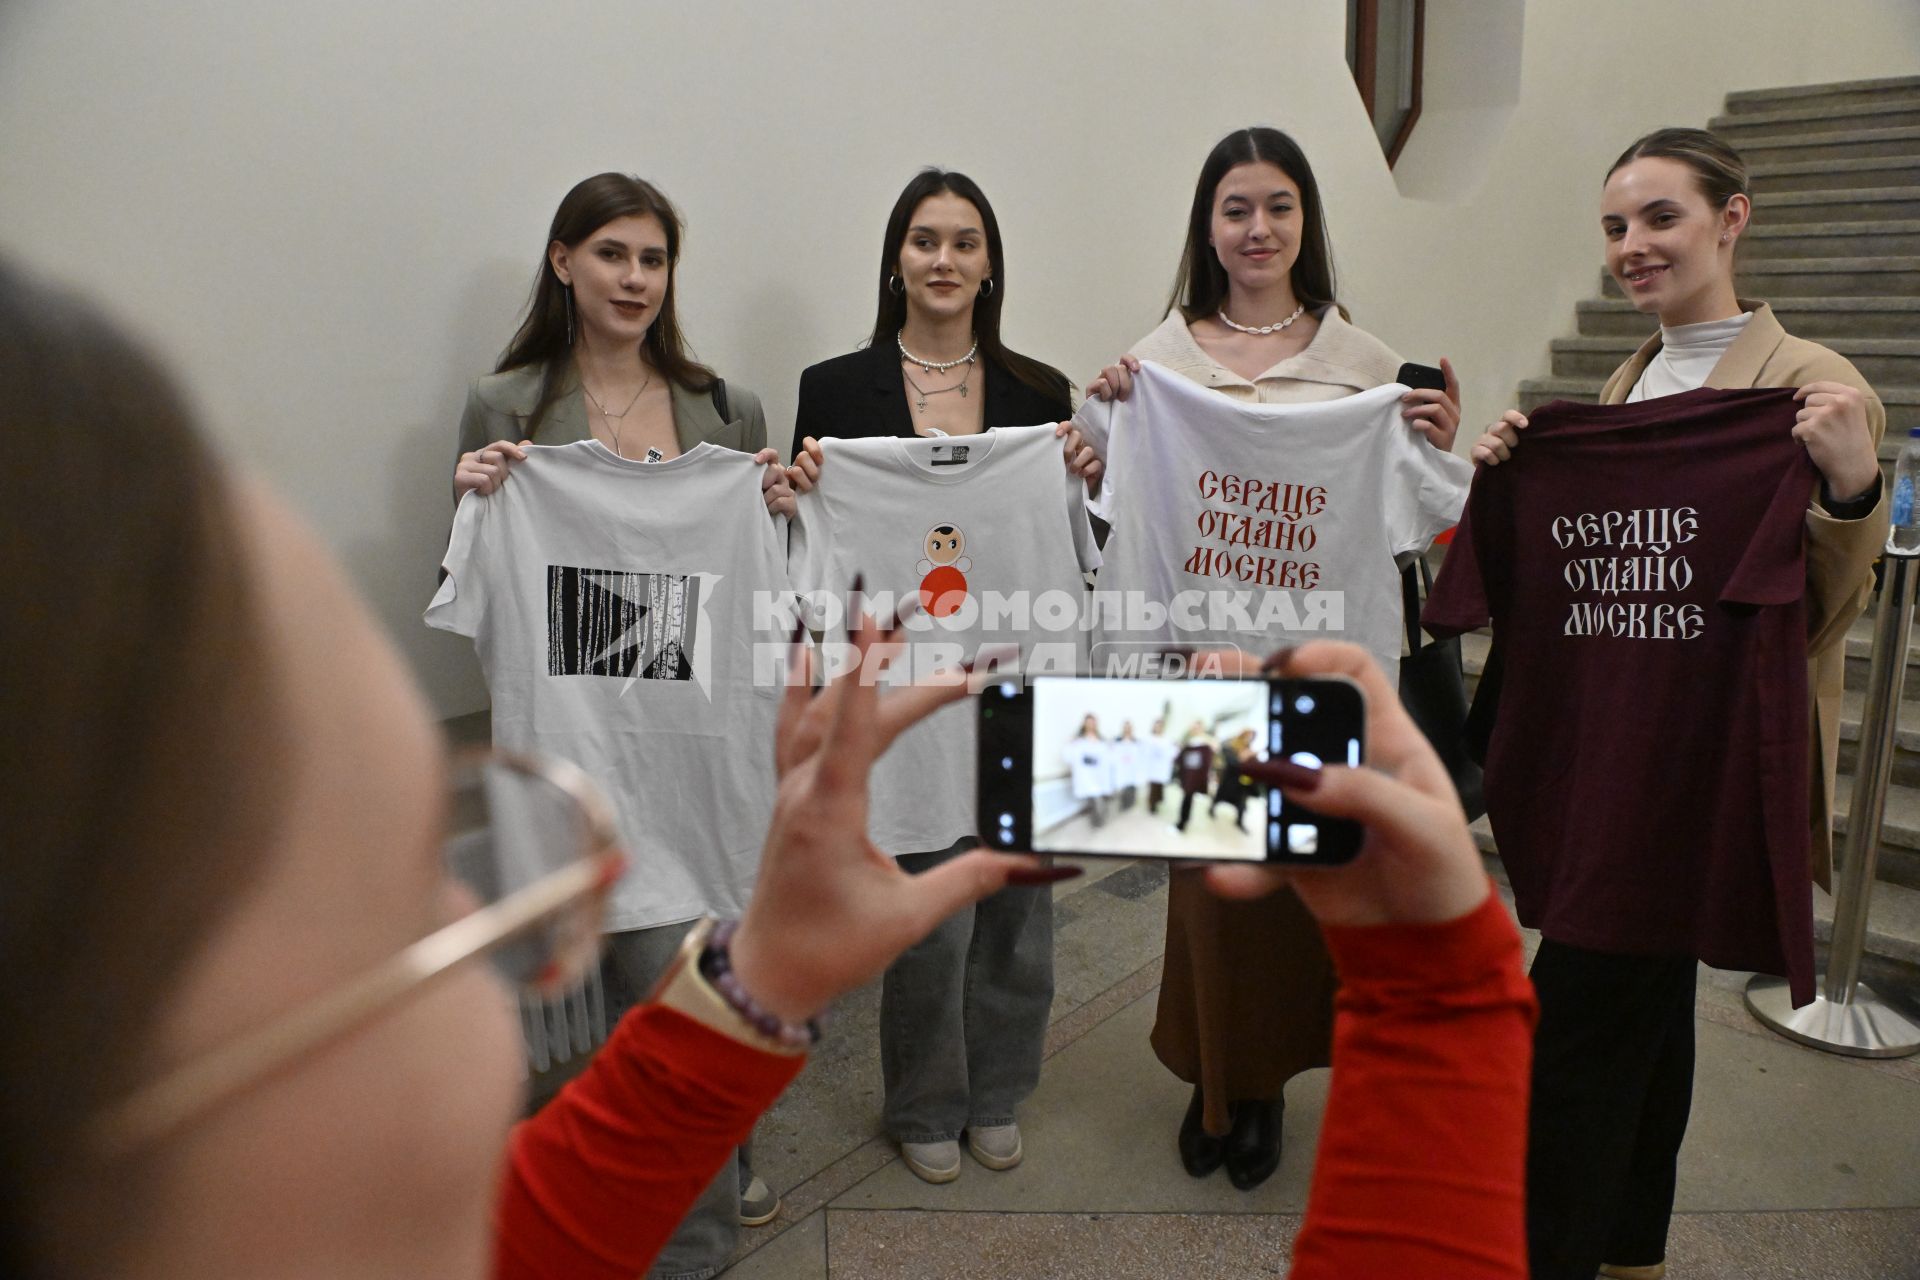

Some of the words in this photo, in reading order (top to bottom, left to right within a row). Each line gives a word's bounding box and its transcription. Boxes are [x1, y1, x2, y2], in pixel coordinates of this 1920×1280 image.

[1198, 470, 1328, 522] СЕРДЦЕ
[1197, 509, 1317, 553] ОТДАНО
[1551, 506, 1700, 555] СЕРДЦЕ
[1184, 546, 1321, 590] МОСКВЕ
[1563, 555, 1693, 597] ОТДАНО
[1563, 602, 1706, 640] МОСКВЕ
